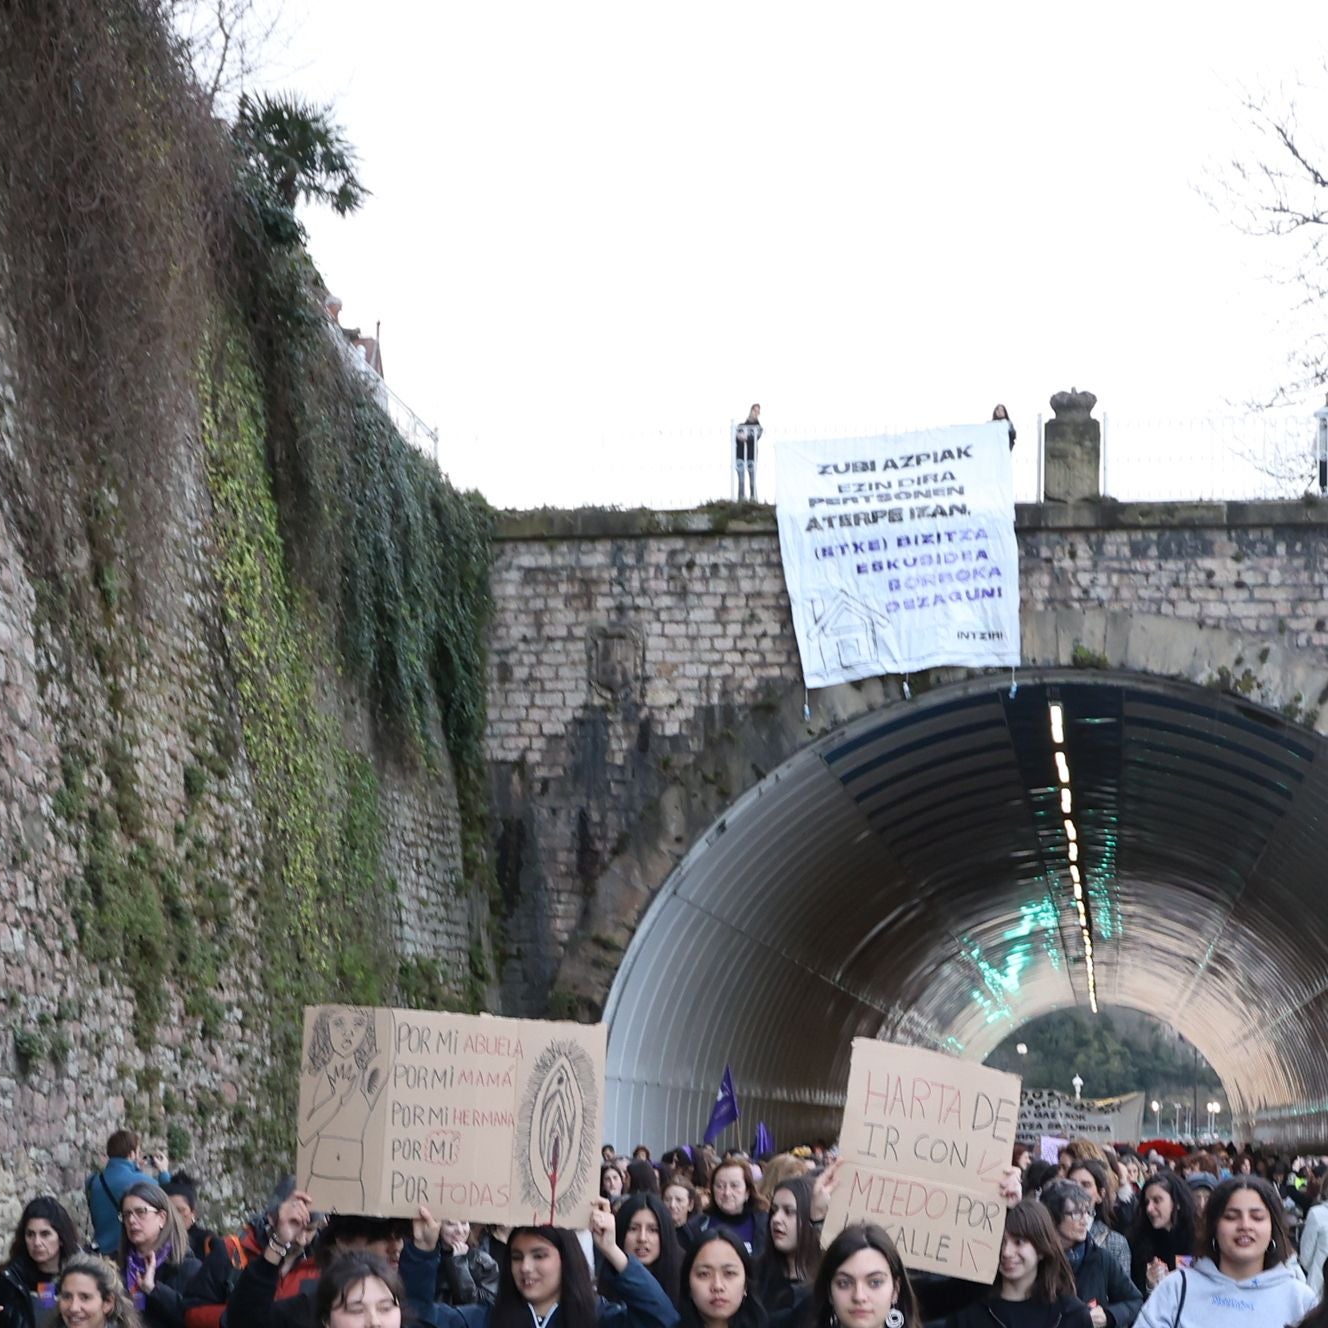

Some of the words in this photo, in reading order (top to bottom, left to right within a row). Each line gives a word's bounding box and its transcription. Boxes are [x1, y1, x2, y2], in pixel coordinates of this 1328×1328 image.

[882, 445, 973, 472] AZPIAK
[805, 507, 903, 531] ATERPE
[397, 1021, 432, 1055] POR
[393, 1063, 429, 1090] POR
[392, 1100, 425, 1128] POR
[452, 1107, 515, 1128] HERMANA
[864, 1070, 962, 1131] HARTA
[971, 1091, 1017, 1143] DE
[392, 1137, 422, 1161] POR
[857, 1121, 900, 1162] IR
[913, 1133, 969, 1168] CON
[391, 1170, 430, 1205] POR
[848, 1170, 949, 1220] MIEDO
[954, 1194, 1000, 1233] POR
